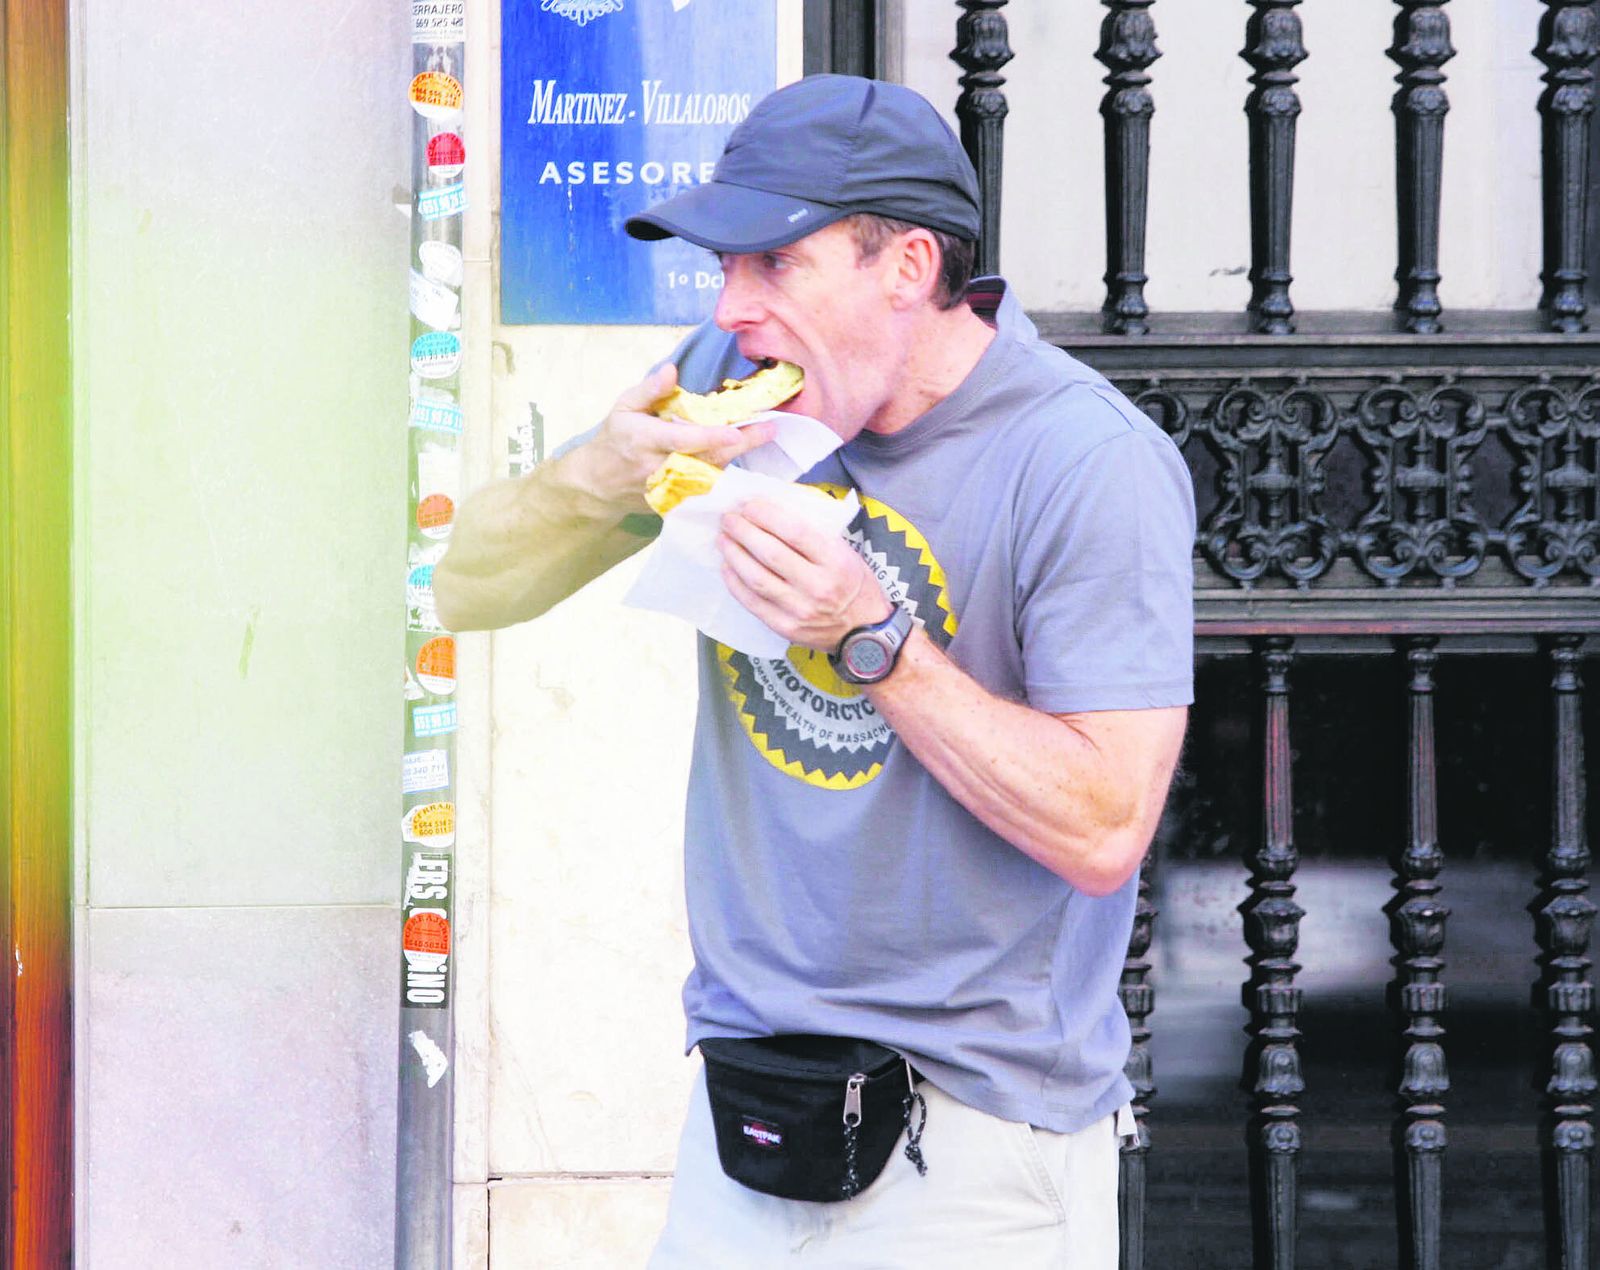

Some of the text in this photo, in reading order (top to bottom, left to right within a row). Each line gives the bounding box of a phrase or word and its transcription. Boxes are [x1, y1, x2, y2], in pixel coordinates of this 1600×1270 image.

[527, 79, 628, 125] MARTINEZ
[641, 79, 750, 125] VILLALOBOS
[539, 161, 716, 185] ASESORE
[819, 728, 834, 739] OF
